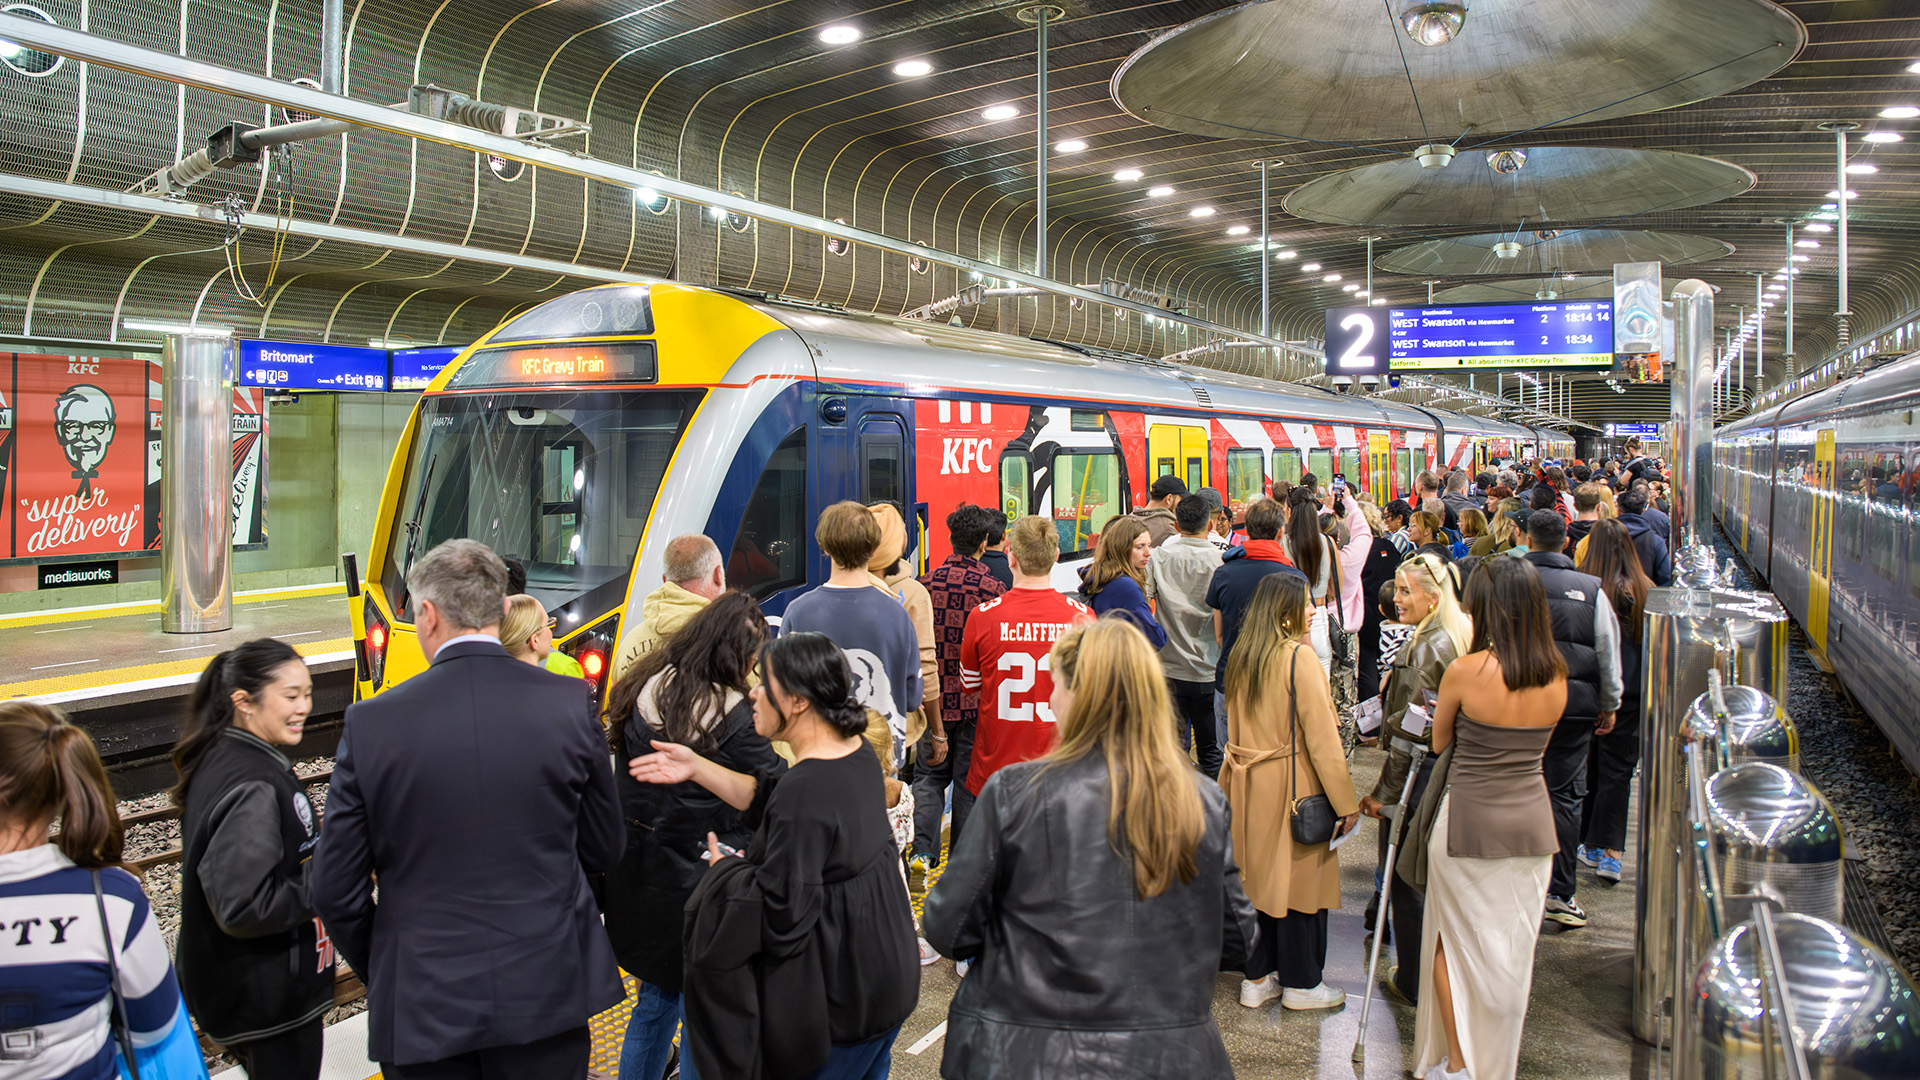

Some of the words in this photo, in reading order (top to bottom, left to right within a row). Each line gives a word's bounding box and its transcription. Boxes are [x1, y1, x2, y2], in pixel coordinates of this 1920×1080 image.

[1392, 318, 1420, 328] WEST
[1421, 318, 1466, 328] Swanson
[1478, 318, 1515, 326] Newmarket
[1540, 313, 1549, 324] 2
[1564, 311, 1593, 323] 18:14
[1596, 311, 1610, 321] 14
[1339, 312, 1376, 368] 2
[1392, 339, 1420, 349] WEST
[1421, 339, 1466, 348] Swanson
[1478, 339, 1515, 347] Newmarket
[1540, 335, 1549, 345] 2
[1564, 333, 1594, 344] 18:34
[260, 349, 314, 364] Britomart
[1530, 357, 1551, 366] Gravy
[67, 363, 99, 375] KFC
[522, 358, 541, 375] KFC
[542, 357, 574, 375] Gravy
[576, 354, 604, 373] Train
[344, 374, 364, 386] Exit
[232, 418, 257, 429] TRAIN
[1605, 424, 1615, 436] 2
[940, 437, 992, 475] KFC
[0, 915, 79, 946] TY
